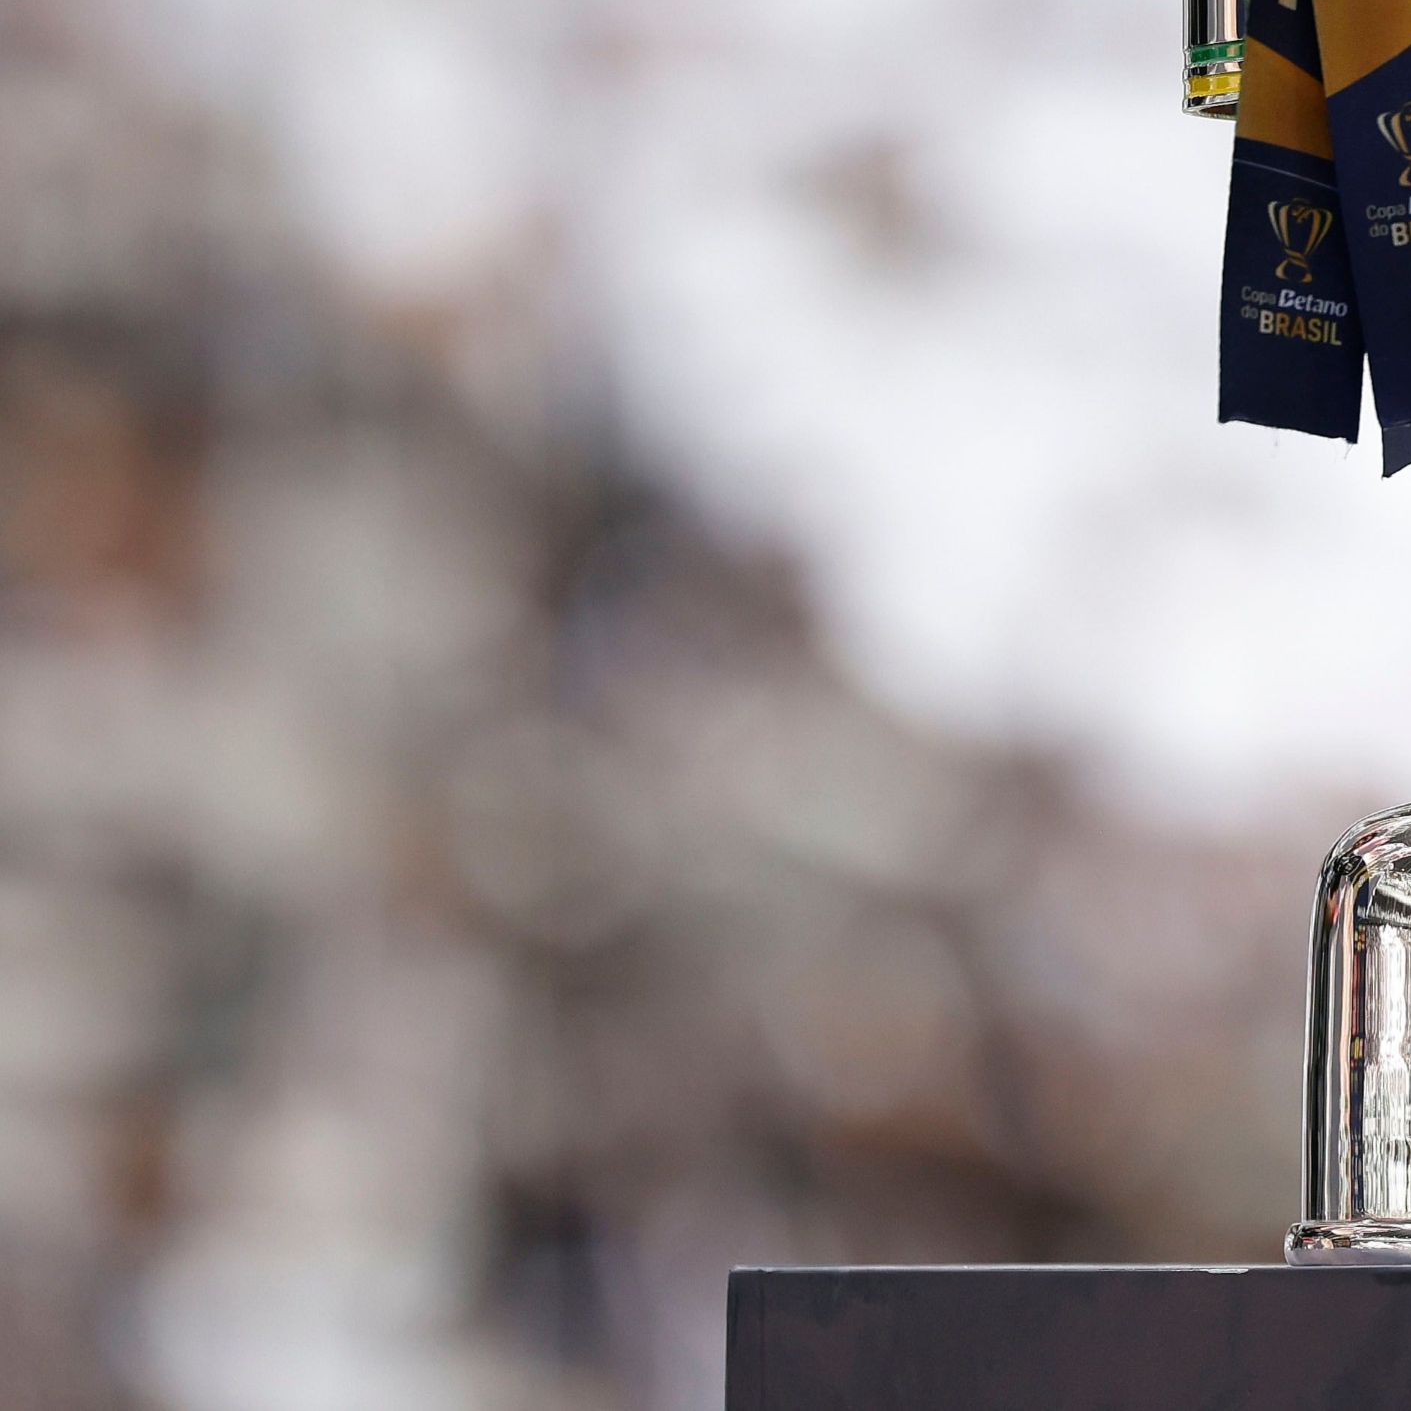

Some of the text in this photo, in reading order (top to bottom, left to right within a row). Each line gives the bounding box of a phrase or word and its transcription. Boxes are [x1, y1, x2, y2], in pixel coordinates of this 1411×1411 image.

[1366, 203, 1406, 222] Copa
[1368, 222, 1390, 238] do
[1241, 285, 1349, 318] Copa Betano
[1240, 304, 1344, 347] do BRASIL
